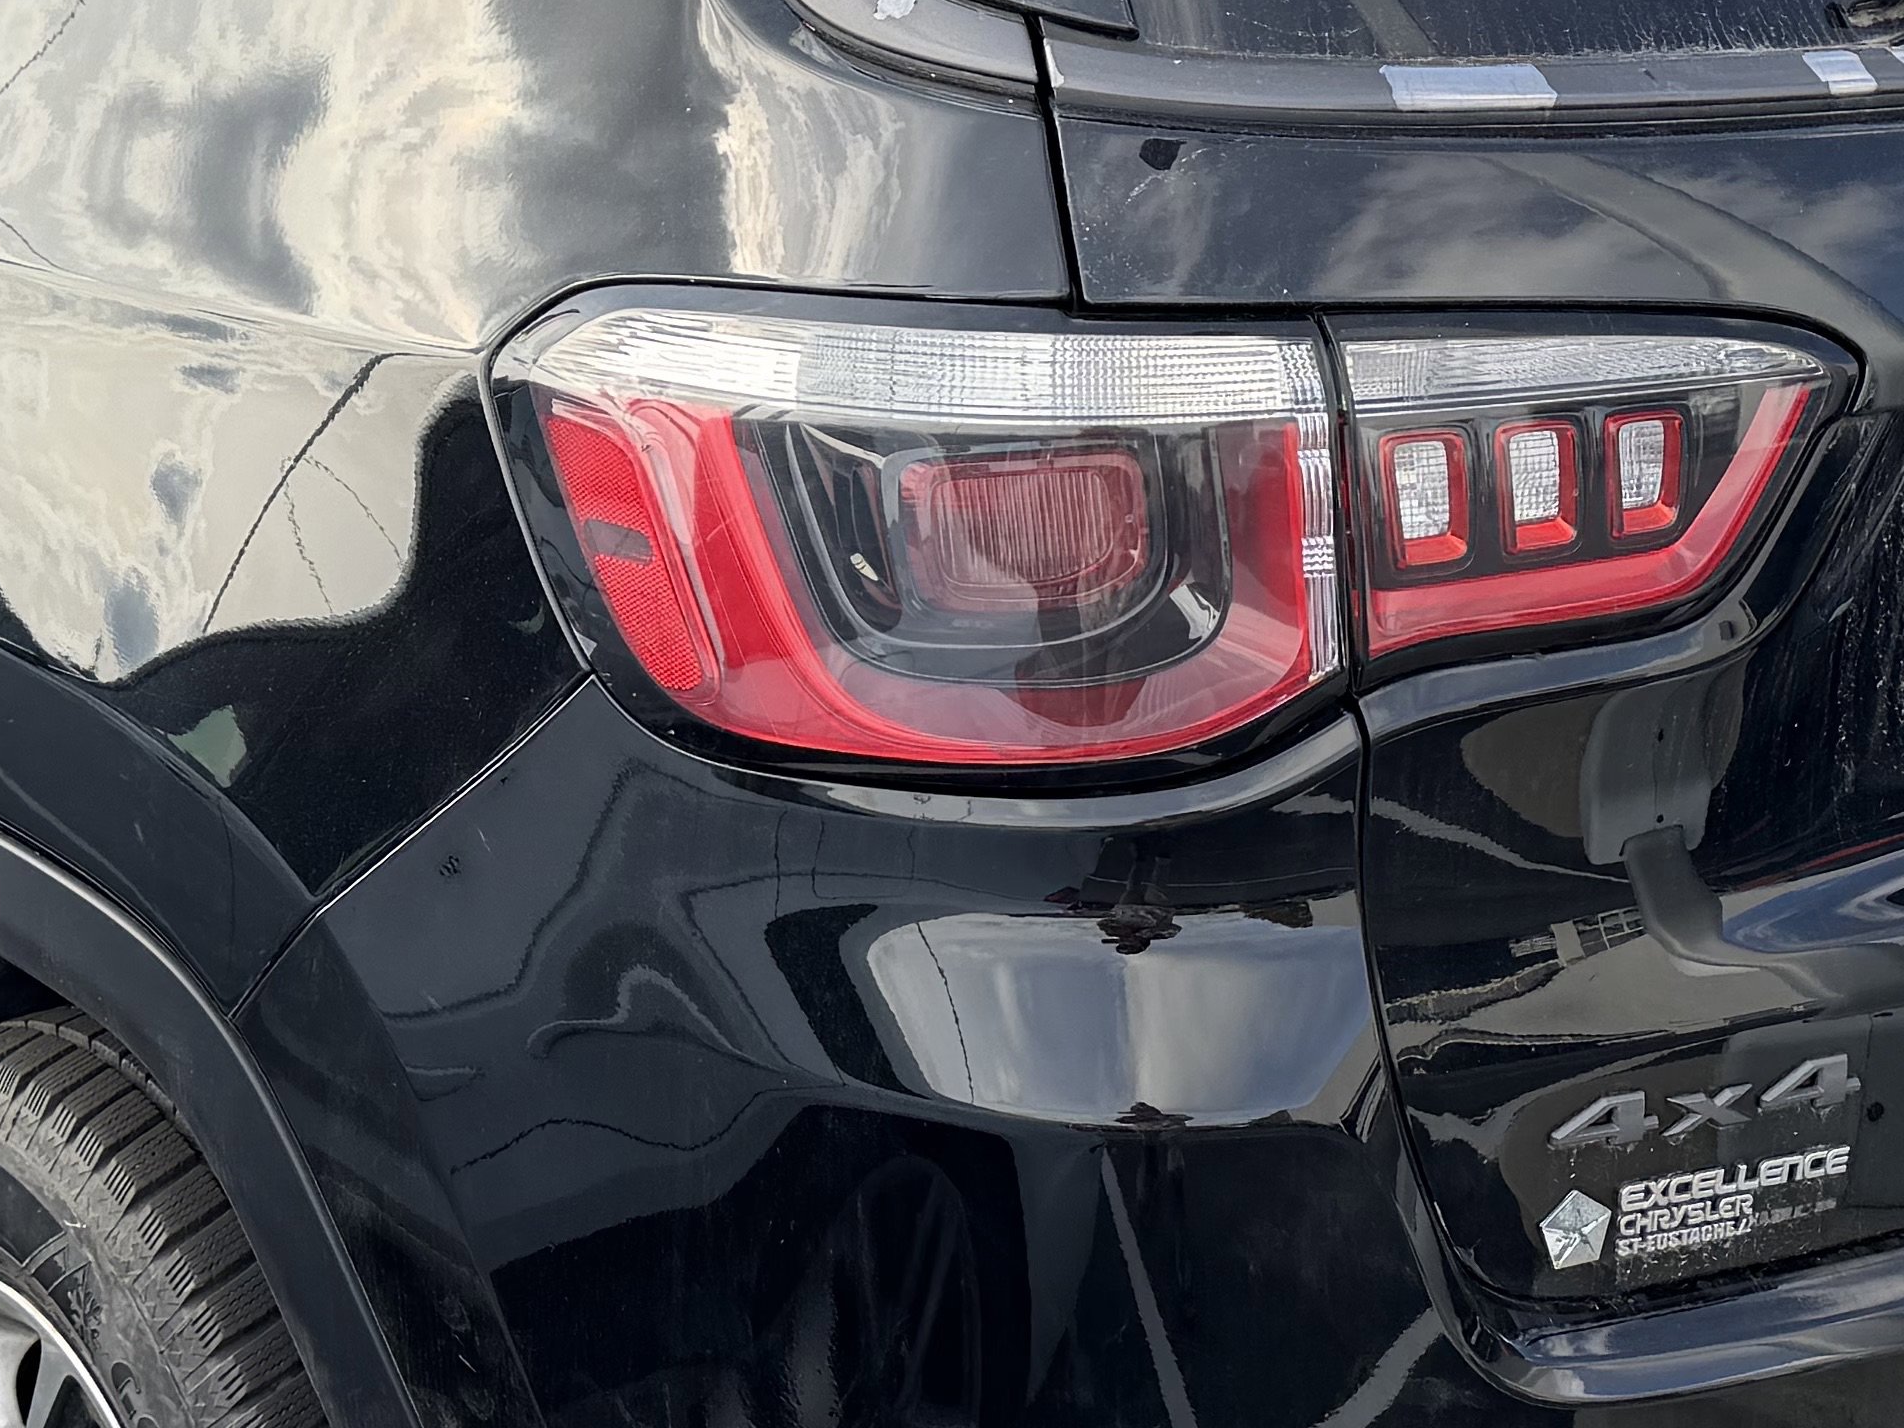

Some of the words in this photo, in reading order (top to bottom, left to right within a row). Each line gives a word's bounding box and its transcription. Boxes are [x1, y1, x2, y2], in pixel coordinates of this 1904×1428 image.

[1548, 1053, 1862, 1150] 4x4
[1619, 1145, 1851, 1213] EXCELLENCE
[1617, 1193, 1754, 1236] CHRYSLER
